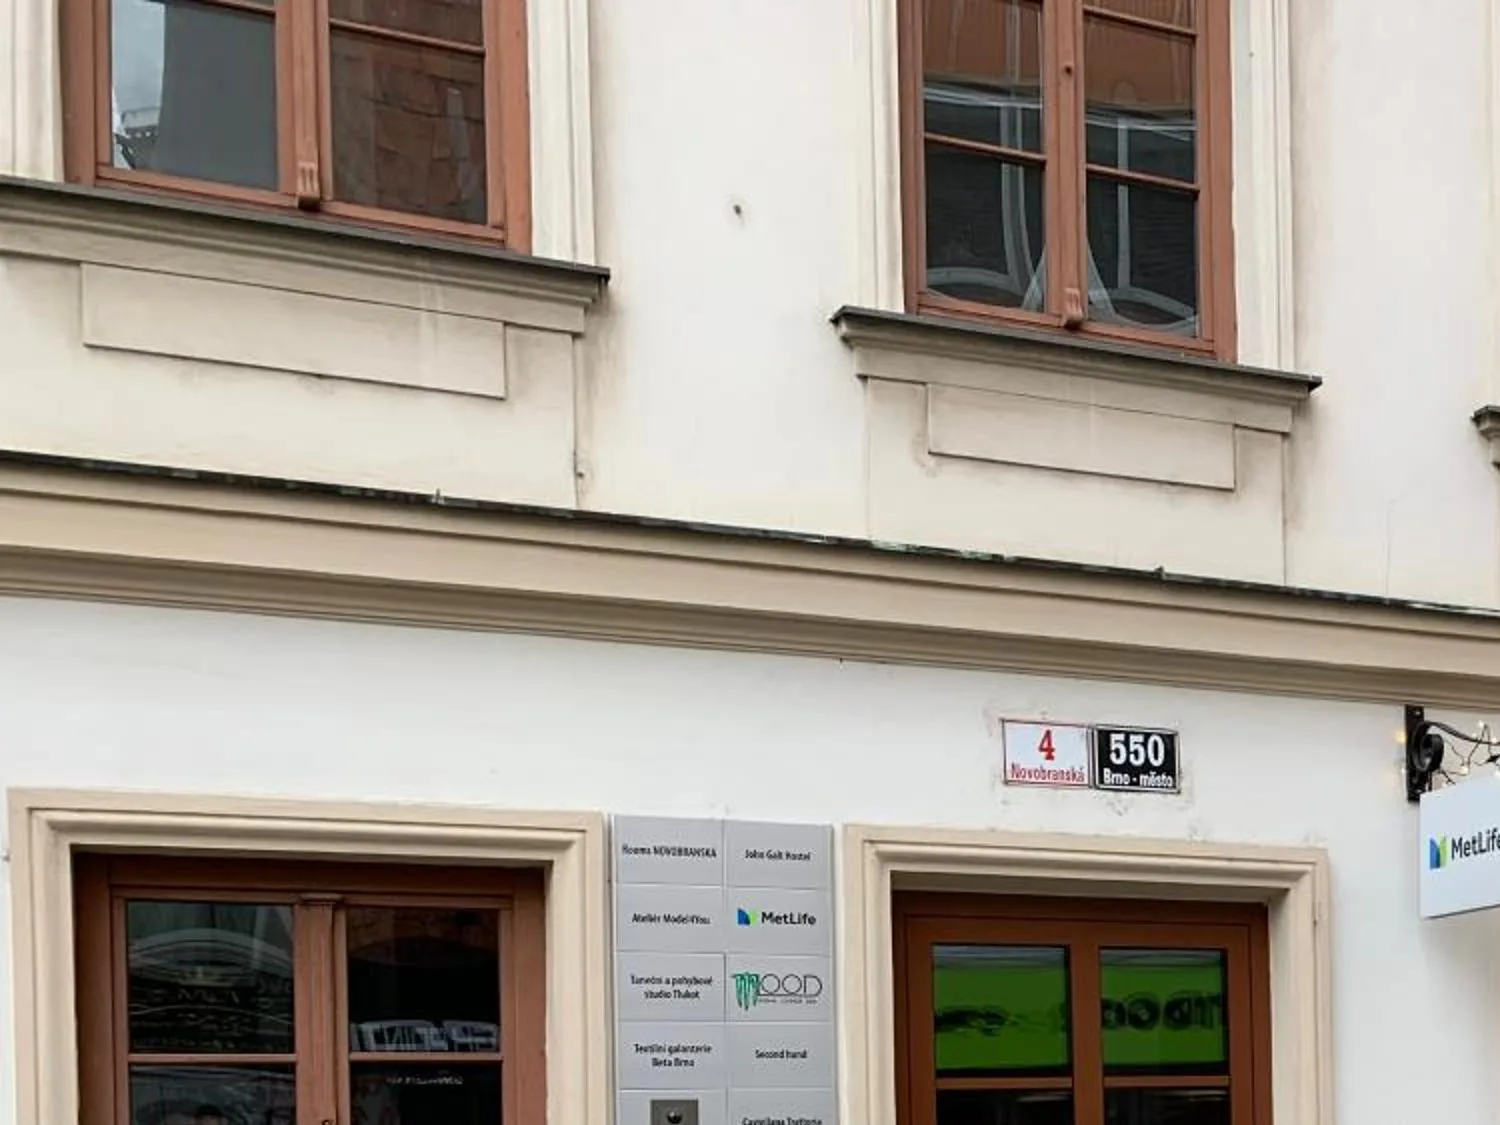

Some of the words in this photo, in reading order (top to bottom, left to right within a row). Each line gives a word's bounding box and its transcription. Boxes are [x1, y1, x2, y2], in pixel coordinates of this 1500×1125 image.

[1038, 729, 1056, 761] 4
[1109, 733, 1166, 767] 550
[1011, 763, 1086, 783] Novobranská
[1103, 767, 1129, 785] Brno
[1139, 770, 1173, 787] město
[761, 911, 817, 925] MetLife
[755, 1049, 785, 1059] Second
